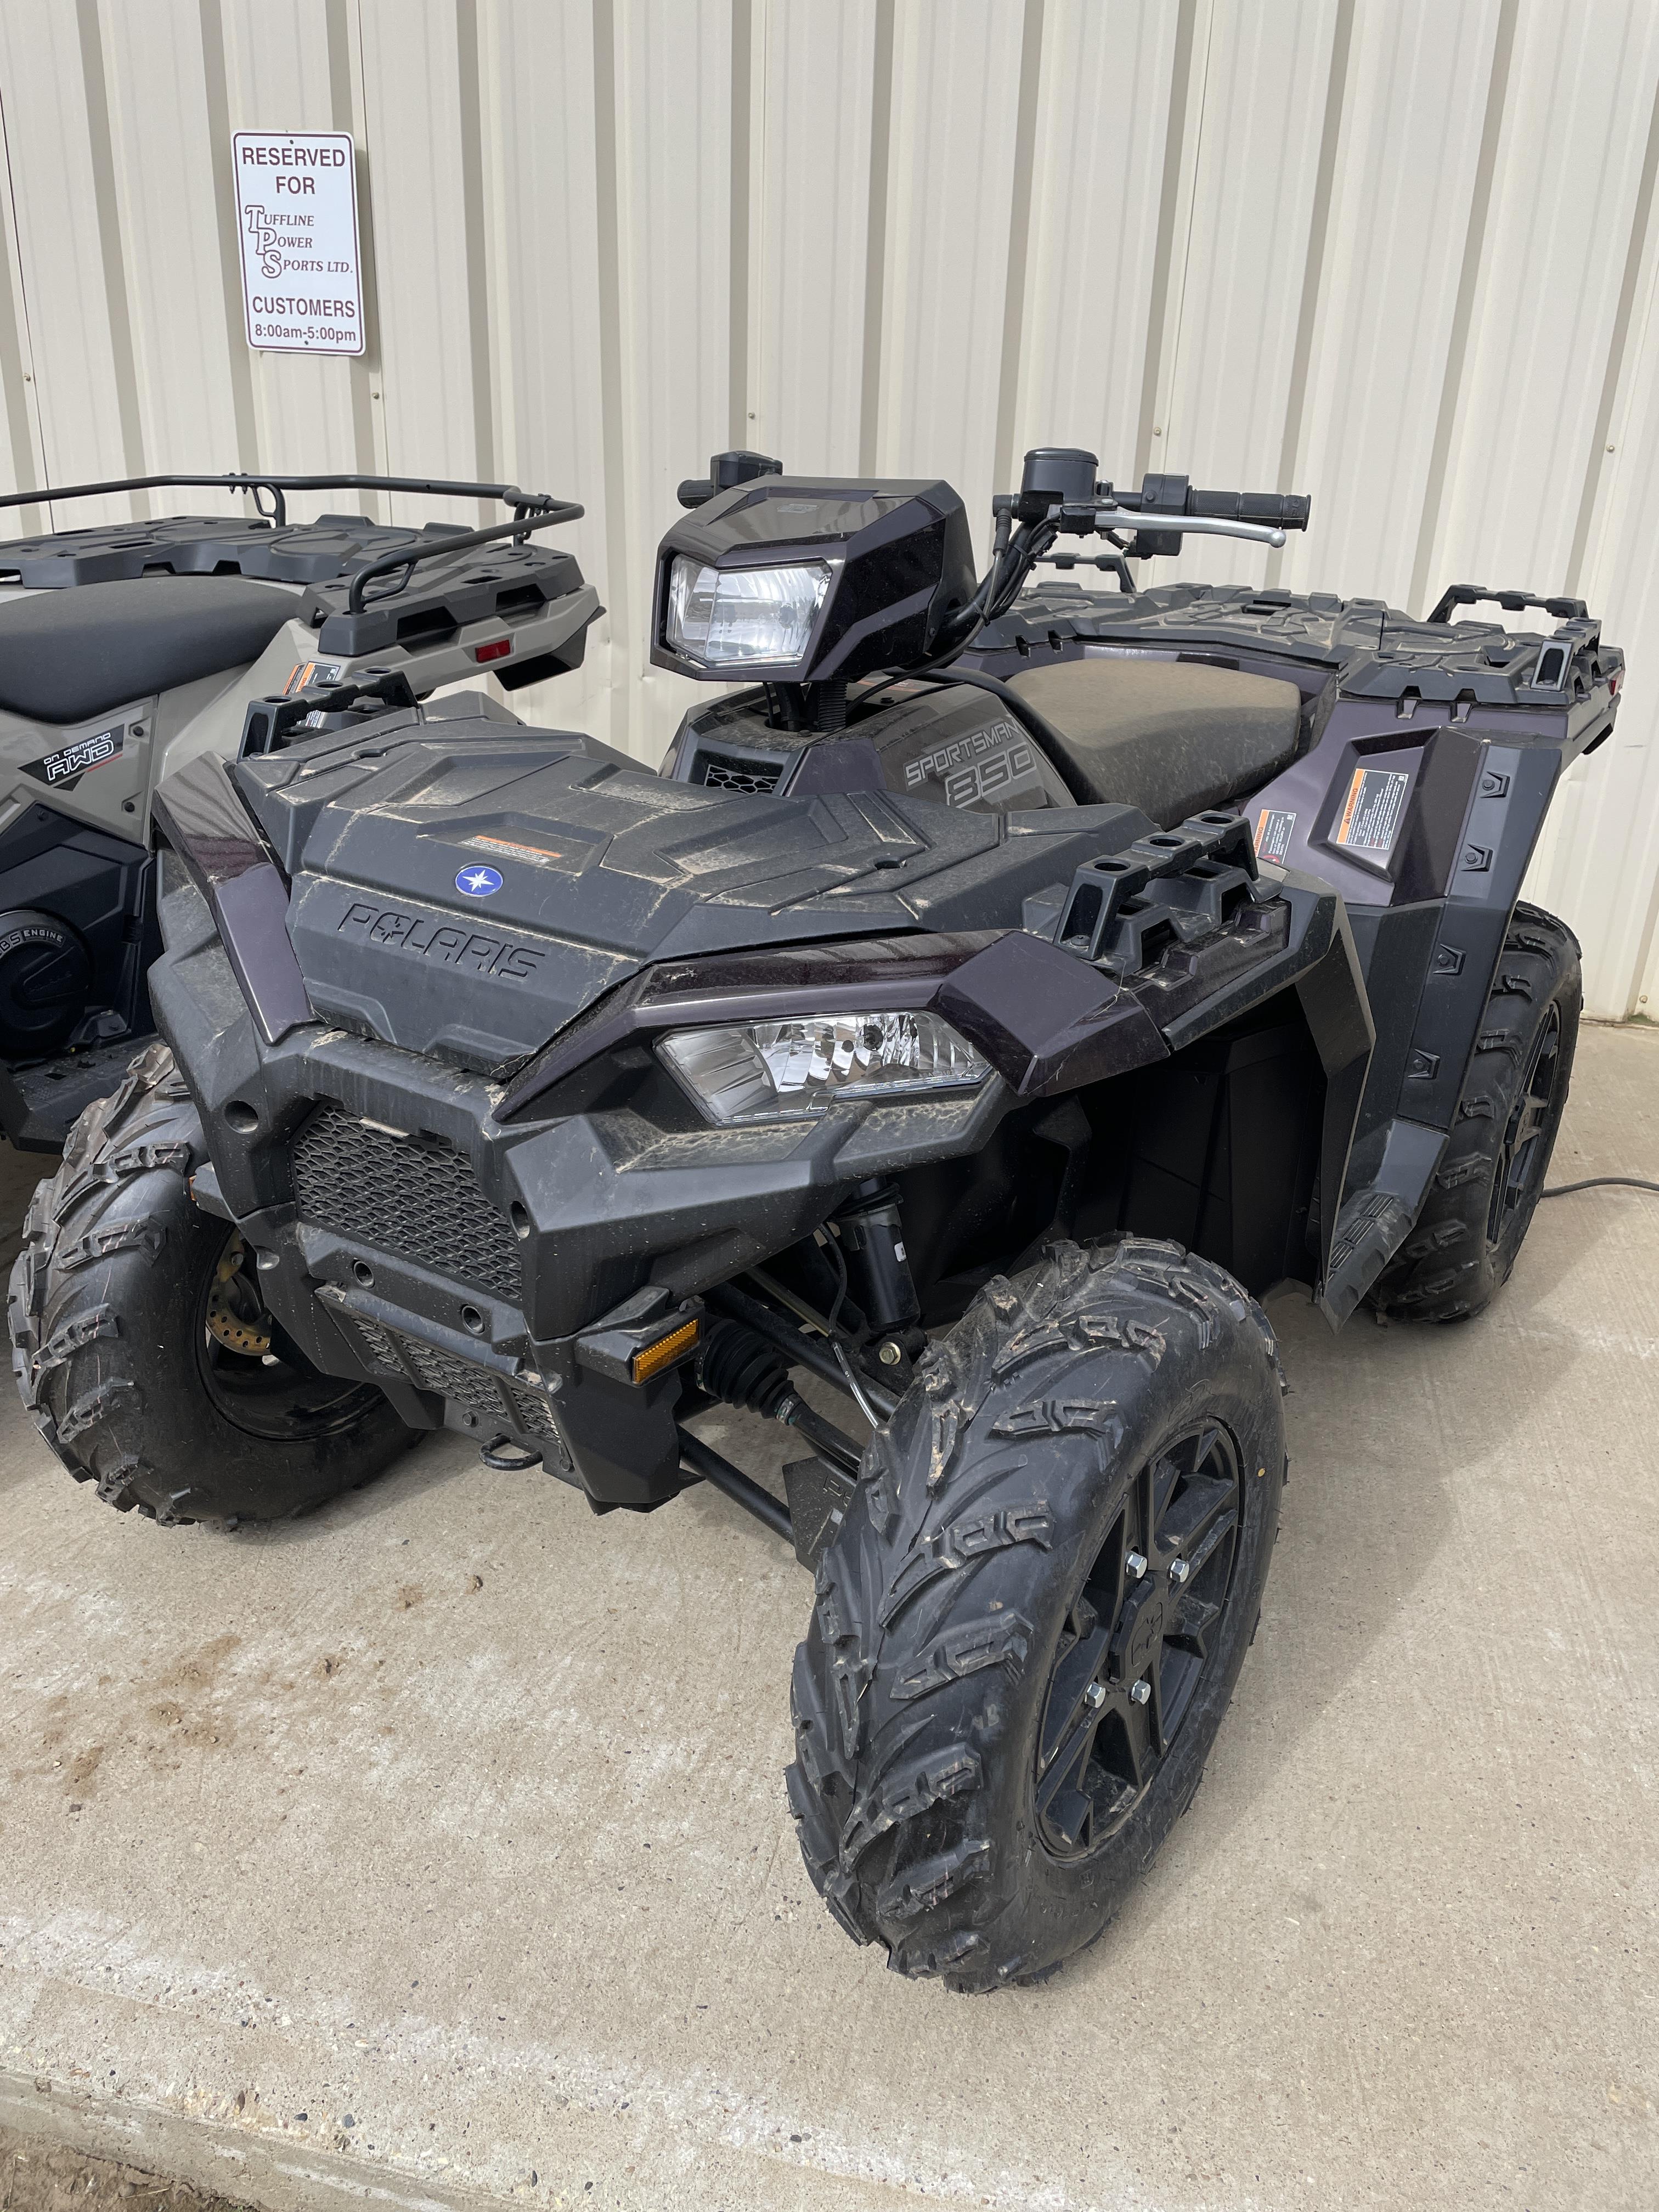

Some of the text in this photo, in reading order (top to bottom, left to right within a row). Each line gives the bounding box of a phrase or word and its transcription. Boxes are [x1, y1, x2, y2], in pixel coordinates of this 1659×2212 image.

[242, 147, 346, 167] RESERVED
[275, 176, 315, 195] FOR
[245, 205, 315, 233] TUFFLINE
[255, 227, 313, 255] POWER
[261, 250, 353, 279] SPORTS LTD.
[252, 296, 356, 318] CUSTOMERS
[255, 324, 356, 343] 8:00am-5:00pm
[43, 732, 111, 765] ON DEMAND
[47, 740, 114, 781] AWD
[905, 719, 1022, 786] SPORTSMAN
[945, 741, 1037, 808] 850
[1346, 787, 1358, 818] WARNING
[1254, 826, 1264, 853] ARNING
[0, 929, 64, 956] BS ENGINE
[337, 902, 546, 980] POLARIS
